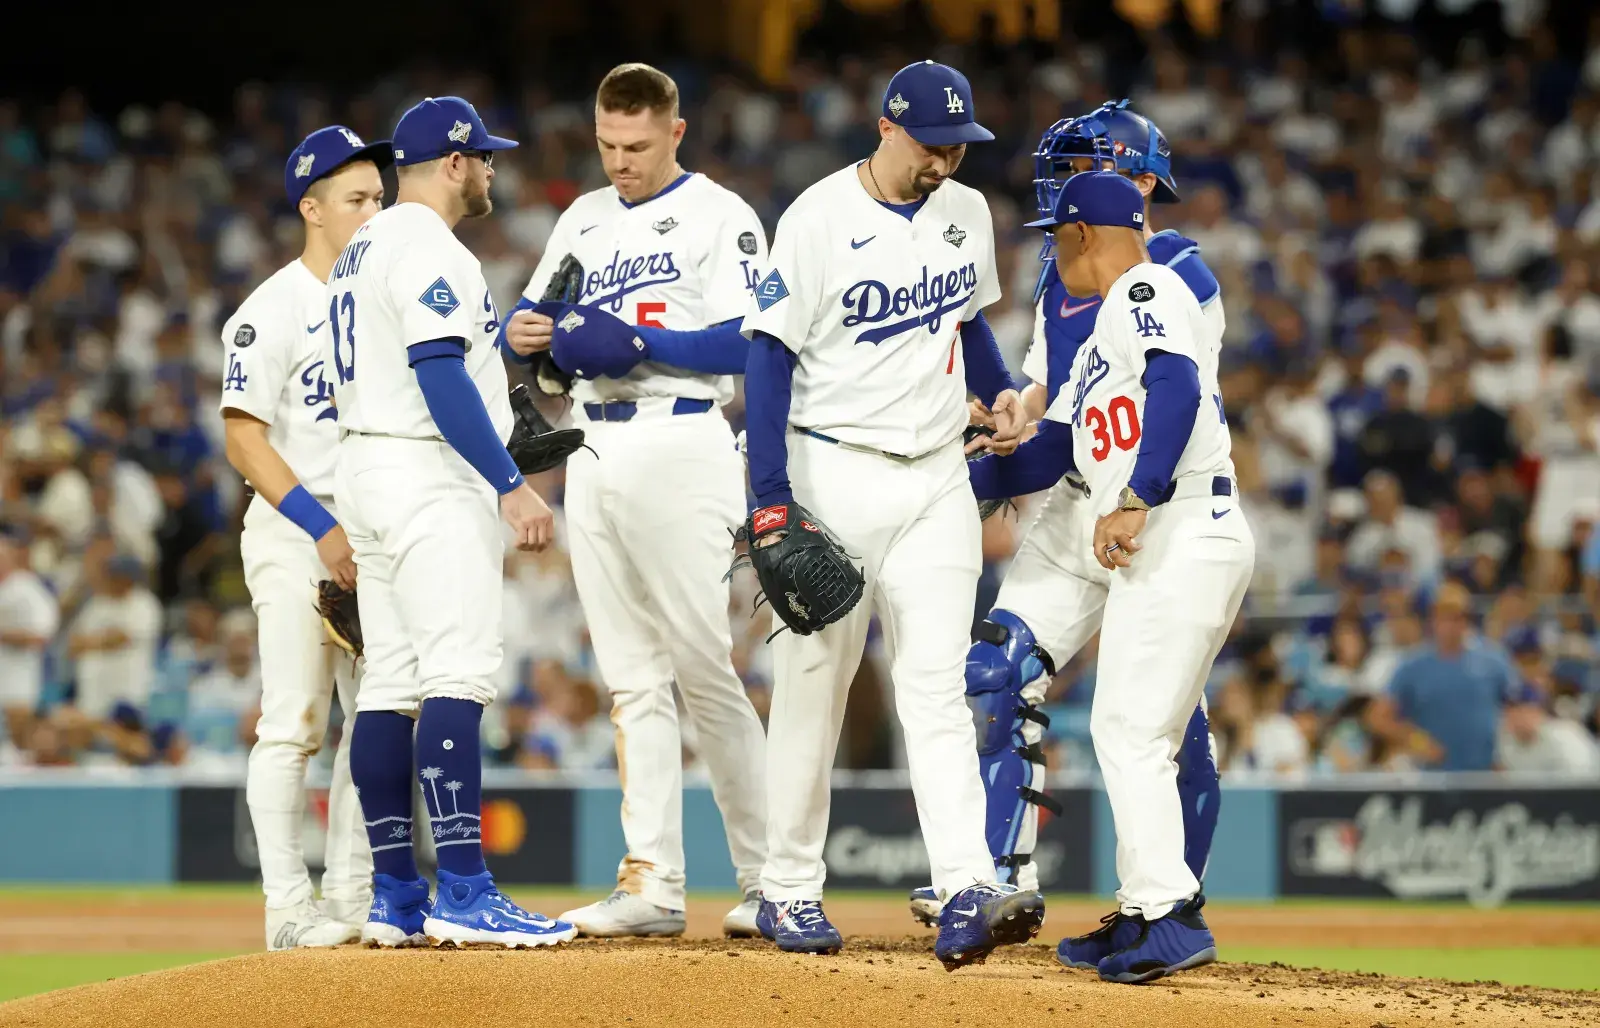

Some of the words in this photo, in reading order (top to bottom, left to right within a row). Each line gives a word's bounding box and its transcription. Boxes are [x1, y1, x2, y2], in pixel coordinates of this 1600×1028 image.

[944, 87, 964, 114] LA
[433, 288, 450, 303] G
[579, 251, 681, 312] odgers
[764, 281, 779, 295] G
[842, 260, 978, 340] Dodgers
[330, 290, 355, 386] 13
[1130, 306, 1166, 337] LA
[225, 352, 248, 391] LA
[1085, 395, 1141, 462] 30
